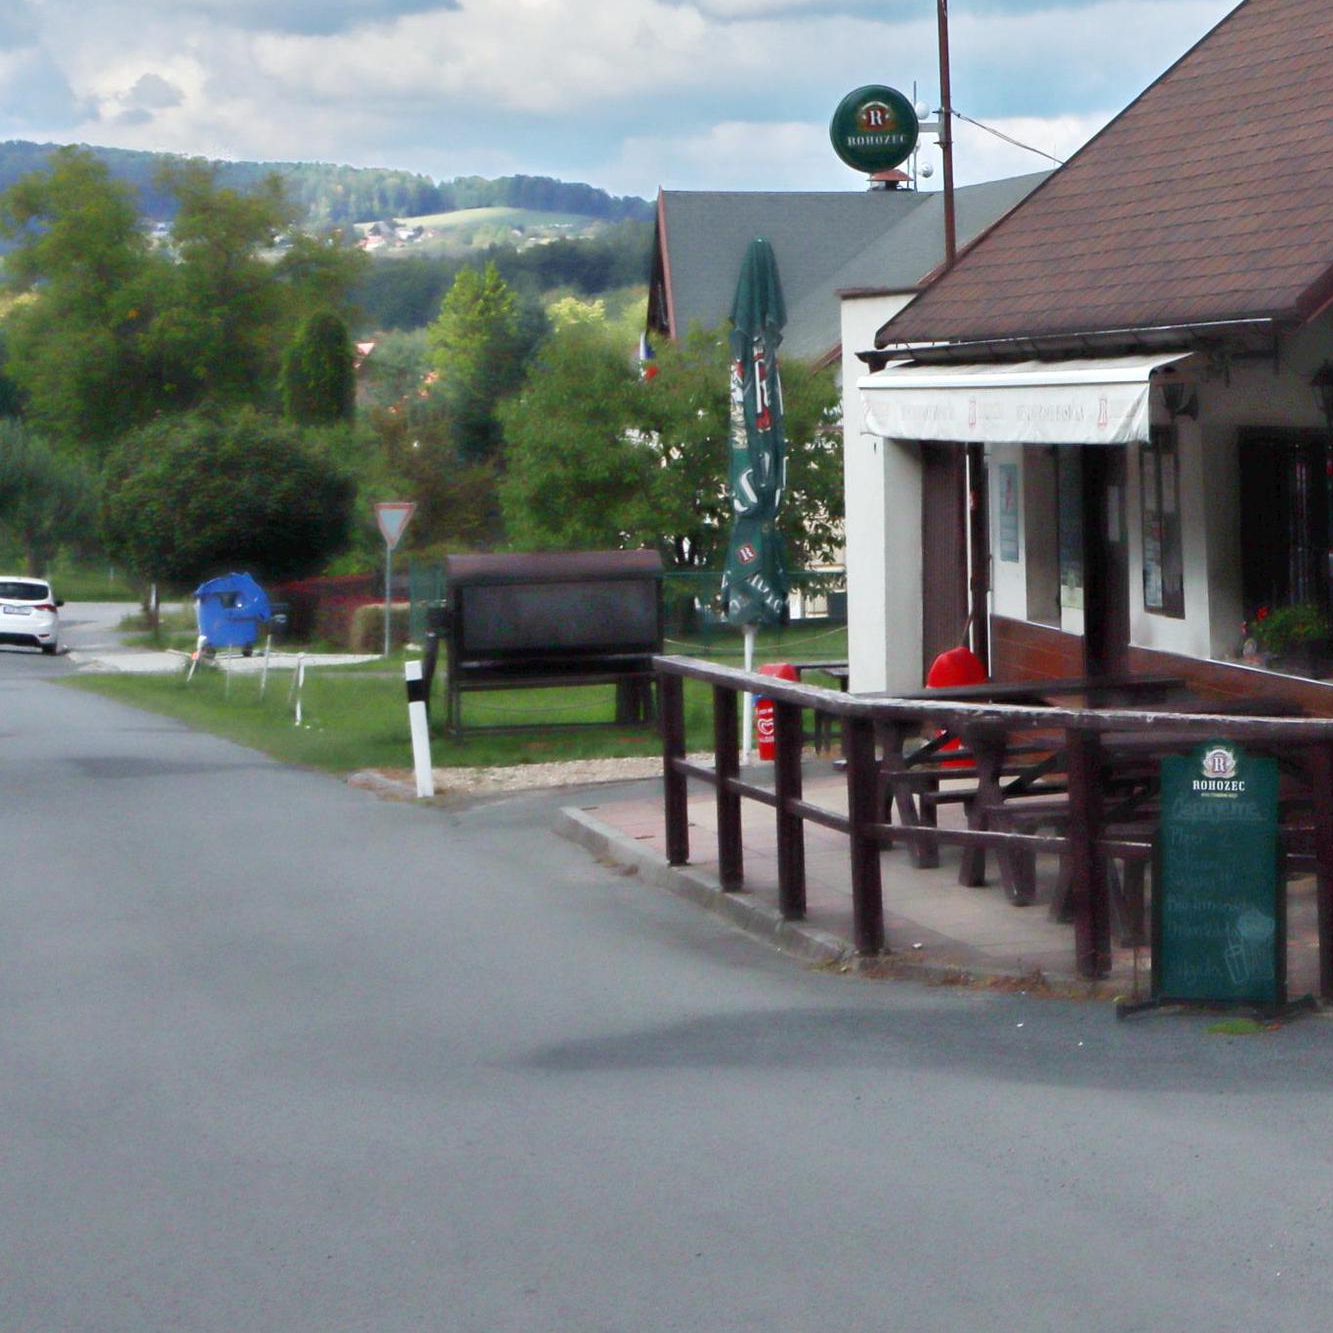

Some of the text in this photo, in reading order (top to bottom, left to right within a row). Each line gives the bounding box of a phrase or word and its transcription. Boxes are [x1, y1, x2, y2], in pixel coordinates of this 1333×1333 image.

[870, 110, 882, 126] R
[1213, 757, 1226, 773] R
[1192, 779, 1246, 792] ROHOZEC
